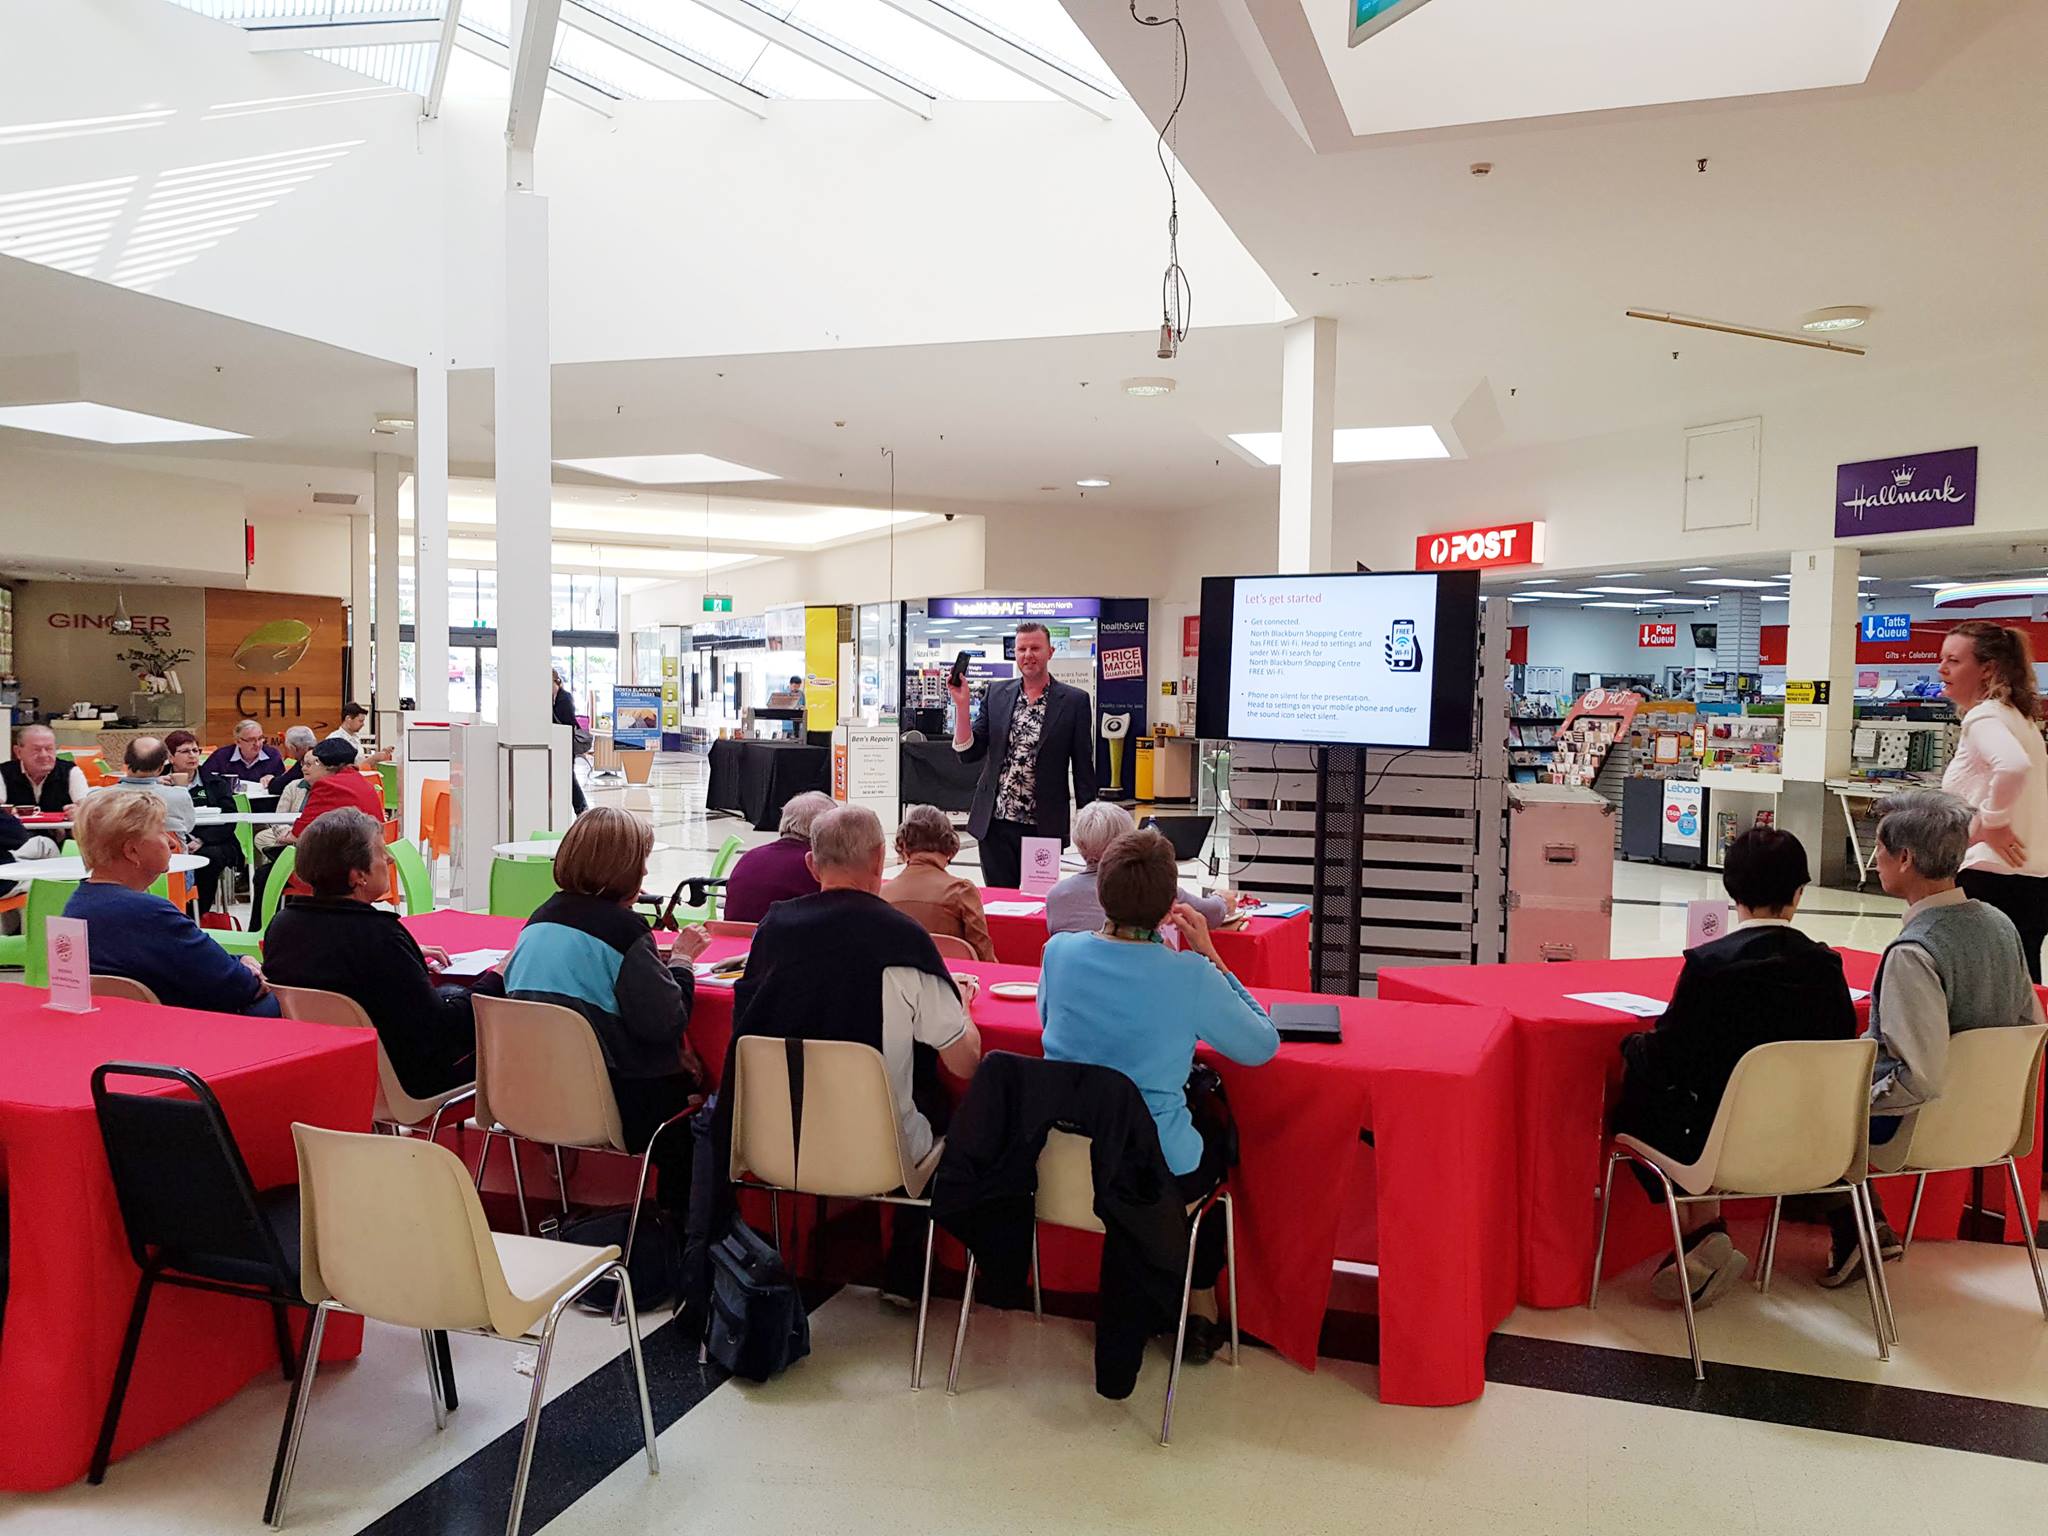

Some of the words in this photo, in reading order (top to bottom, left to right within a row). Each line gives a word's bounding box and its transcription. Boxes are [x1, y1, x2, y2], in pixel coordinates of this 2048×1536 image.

[1842, 475, 1966, 520] Hallmark
[1450, 529, 1517, 562] POST
[1245, 593, 1267, 604] Let's
[1269, 594, 1284, 606] get
[1287, 593, 1322, 604] started
[1056, 601, 1073, 609] North
[1027, 608, 1056, 616] Pharmacy
[1250, 618, 1263, 626] Get
[1883, 616, 1906, 627] Tatts
[1305, 630, 1337, 639] Shopping
[1656, 625, 1673, 635] Post
[1876, 627, 1908, 638] Queue
[1650, 634, 1675, 644] Queue
[1301, 640, 1319, 648] Head
[1329, 641, 1357, 649] settings
[1358, 640, 1372, 648] and
[1103, 649, 1140, 662] PRICE
[1885, 651, 1900, 659] Gifts
[1908, 651, 1938, 659] Celebrate
[1104, 659, 1141, 672] MATCH
[1270, 659, 1303, 667] Blackburn
[1304, 659, 1336, 668] Shopping
[1105, 669, 1141, 678] GUARANTEE
[1247, 691, 1269, 699] Phone
[1311, 692, 1323, 700] the
[236, 686, 300, 718] CHI
[1247, 701, 1265, 709] Head
[1274, 702, 1300, 711] settings
[1312, 703, 1328, 711] your
[1329, 703, 1354, 711] mobile
[1355, 704, 1378, 712] phone
[1379, 705, 1394, 713] and
[1394, 705, 1417, 713] under
[1296, 712, 1316, 720] select
[1666, 783, 1701, 795] Lebara
